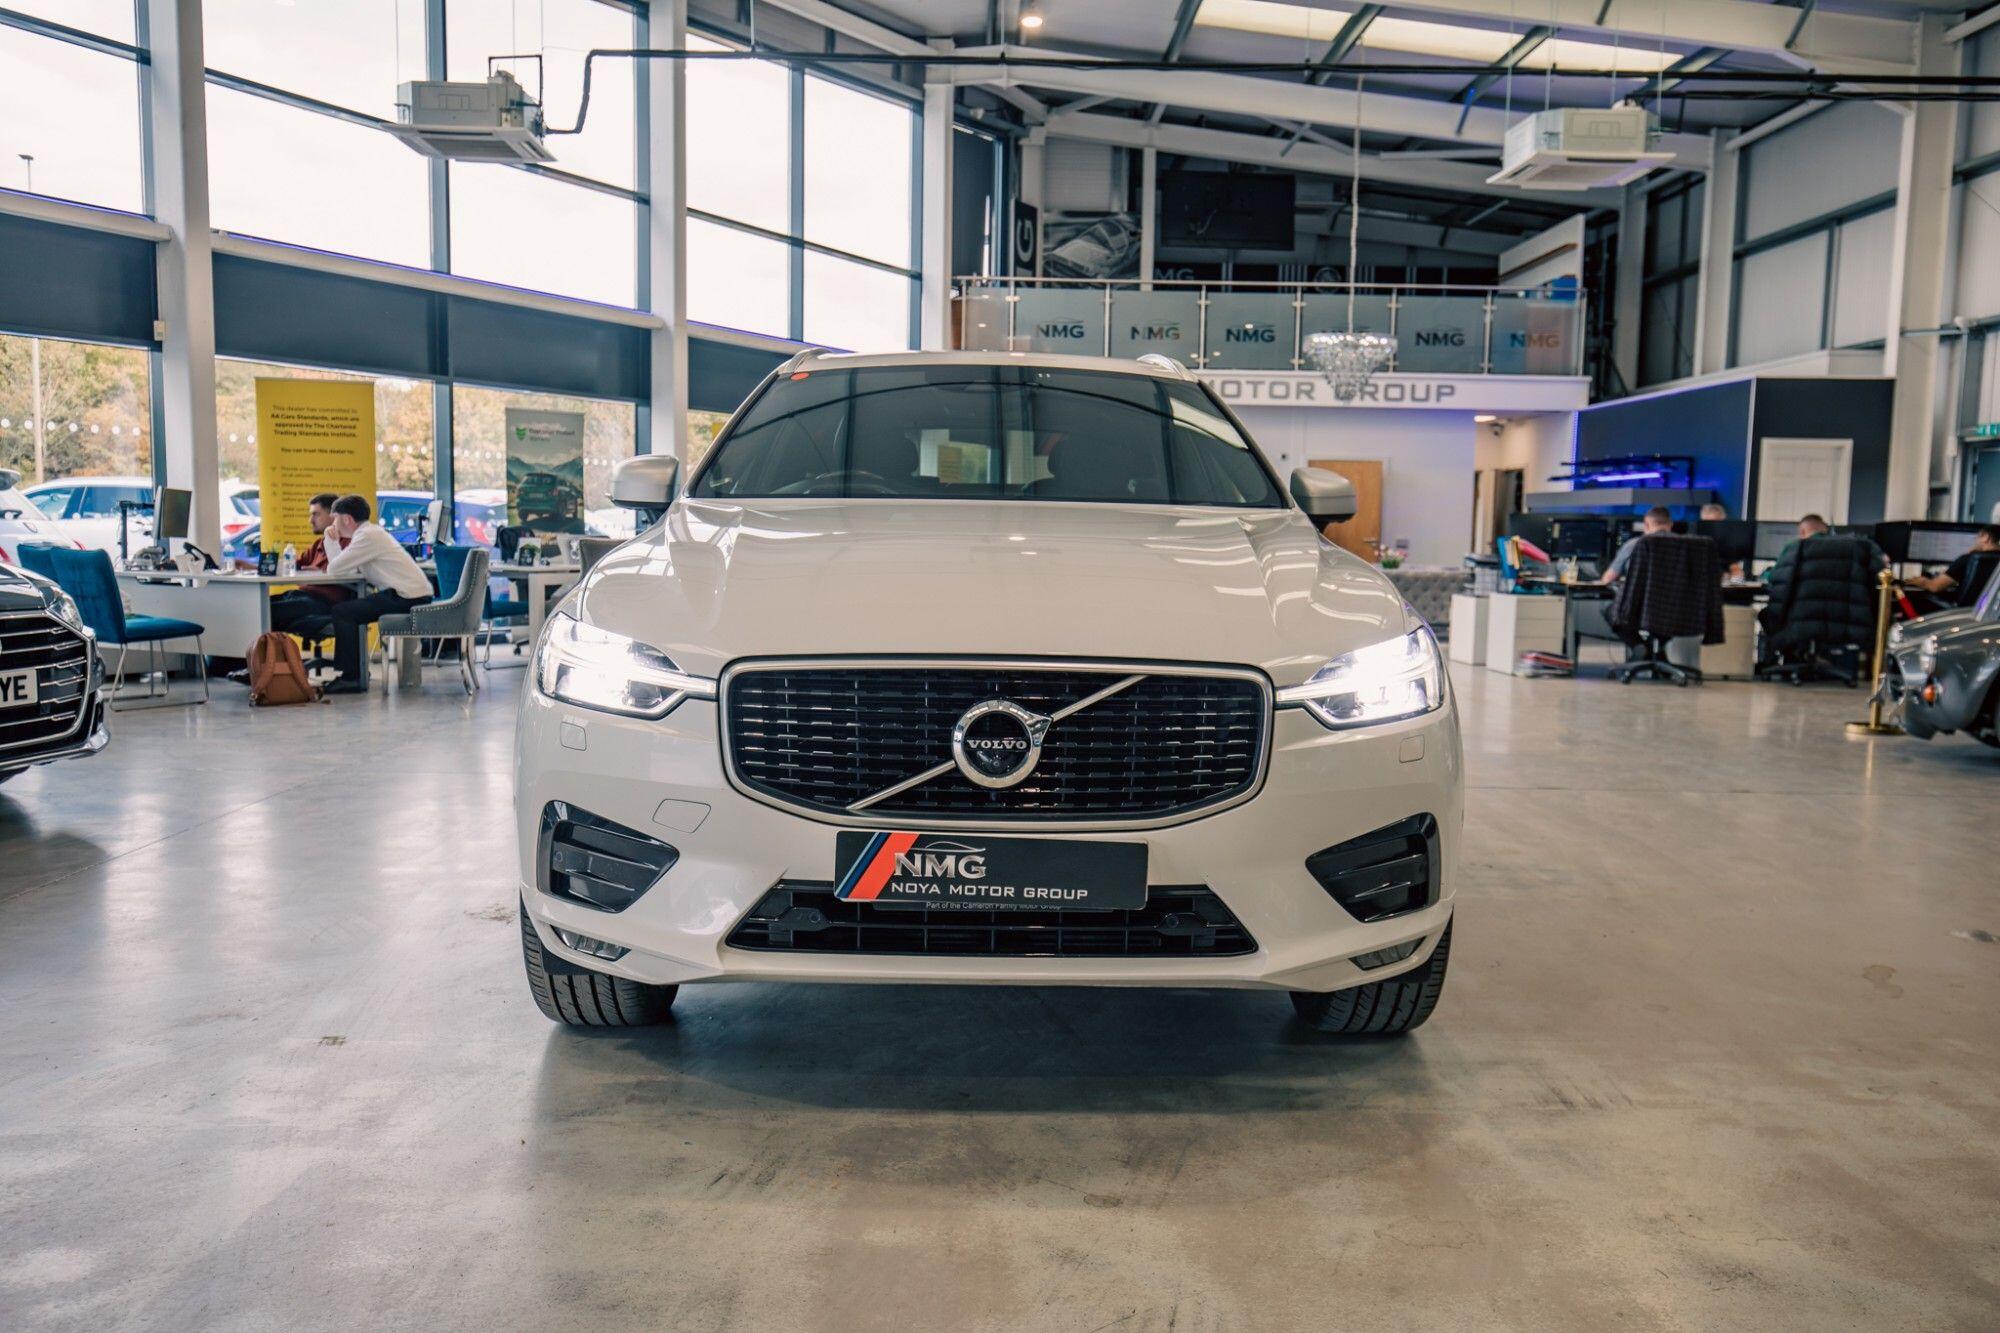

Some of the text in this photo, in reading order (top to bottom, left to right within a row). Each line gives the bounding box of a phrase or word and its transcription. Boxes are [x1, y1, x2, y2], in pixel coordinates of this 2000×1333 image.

[1036, 324, 1085, 339] NMG
[1130, 326, 1180, 340] NMG
[1225, 328, 1275, 343] NMG
[1415, 332, 1465, 347] NMG
[1510, 333, 1560, 348] NMG
[1208, 380, 1455, 402] OTOR GROUP
[967, 740, 1028, 749] VOLVO
[894, 852, 986, 879] NMG
[891, 882, 1088, 900] NOYA MOTOR GROUP
[926, 901, 940, 909] Part
